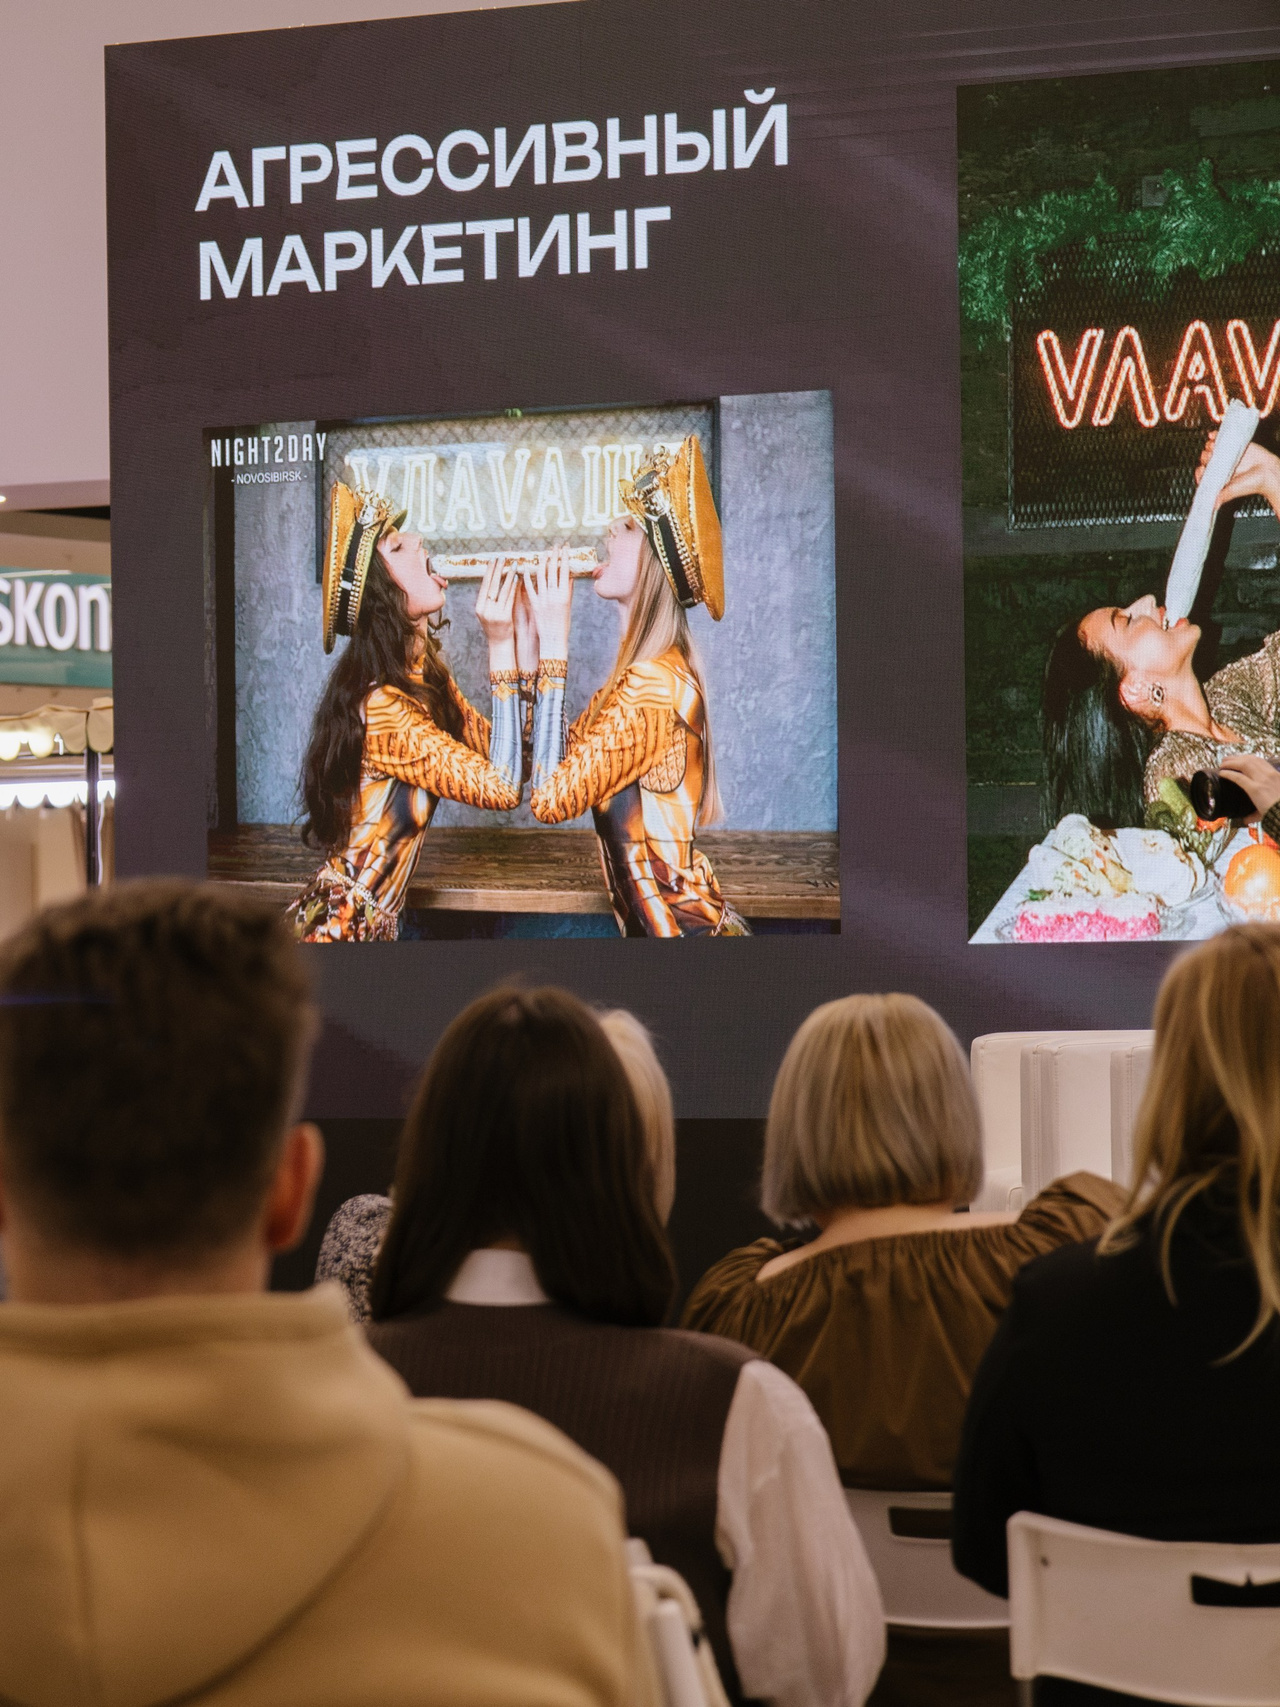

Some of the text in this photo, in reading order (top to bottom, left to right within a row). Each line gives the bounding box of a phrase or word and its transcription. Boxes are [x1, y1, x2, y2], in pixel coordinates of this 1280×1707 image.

[195, 87, 788, 212] АГРЕССИВНЫЙ
[199, 206, 671, 300] МАРКЕТИНГ
[210, 432, 327, 468] NIGHT2DAY
[236, 470, 302, 485] NOVOSIBIRSK
